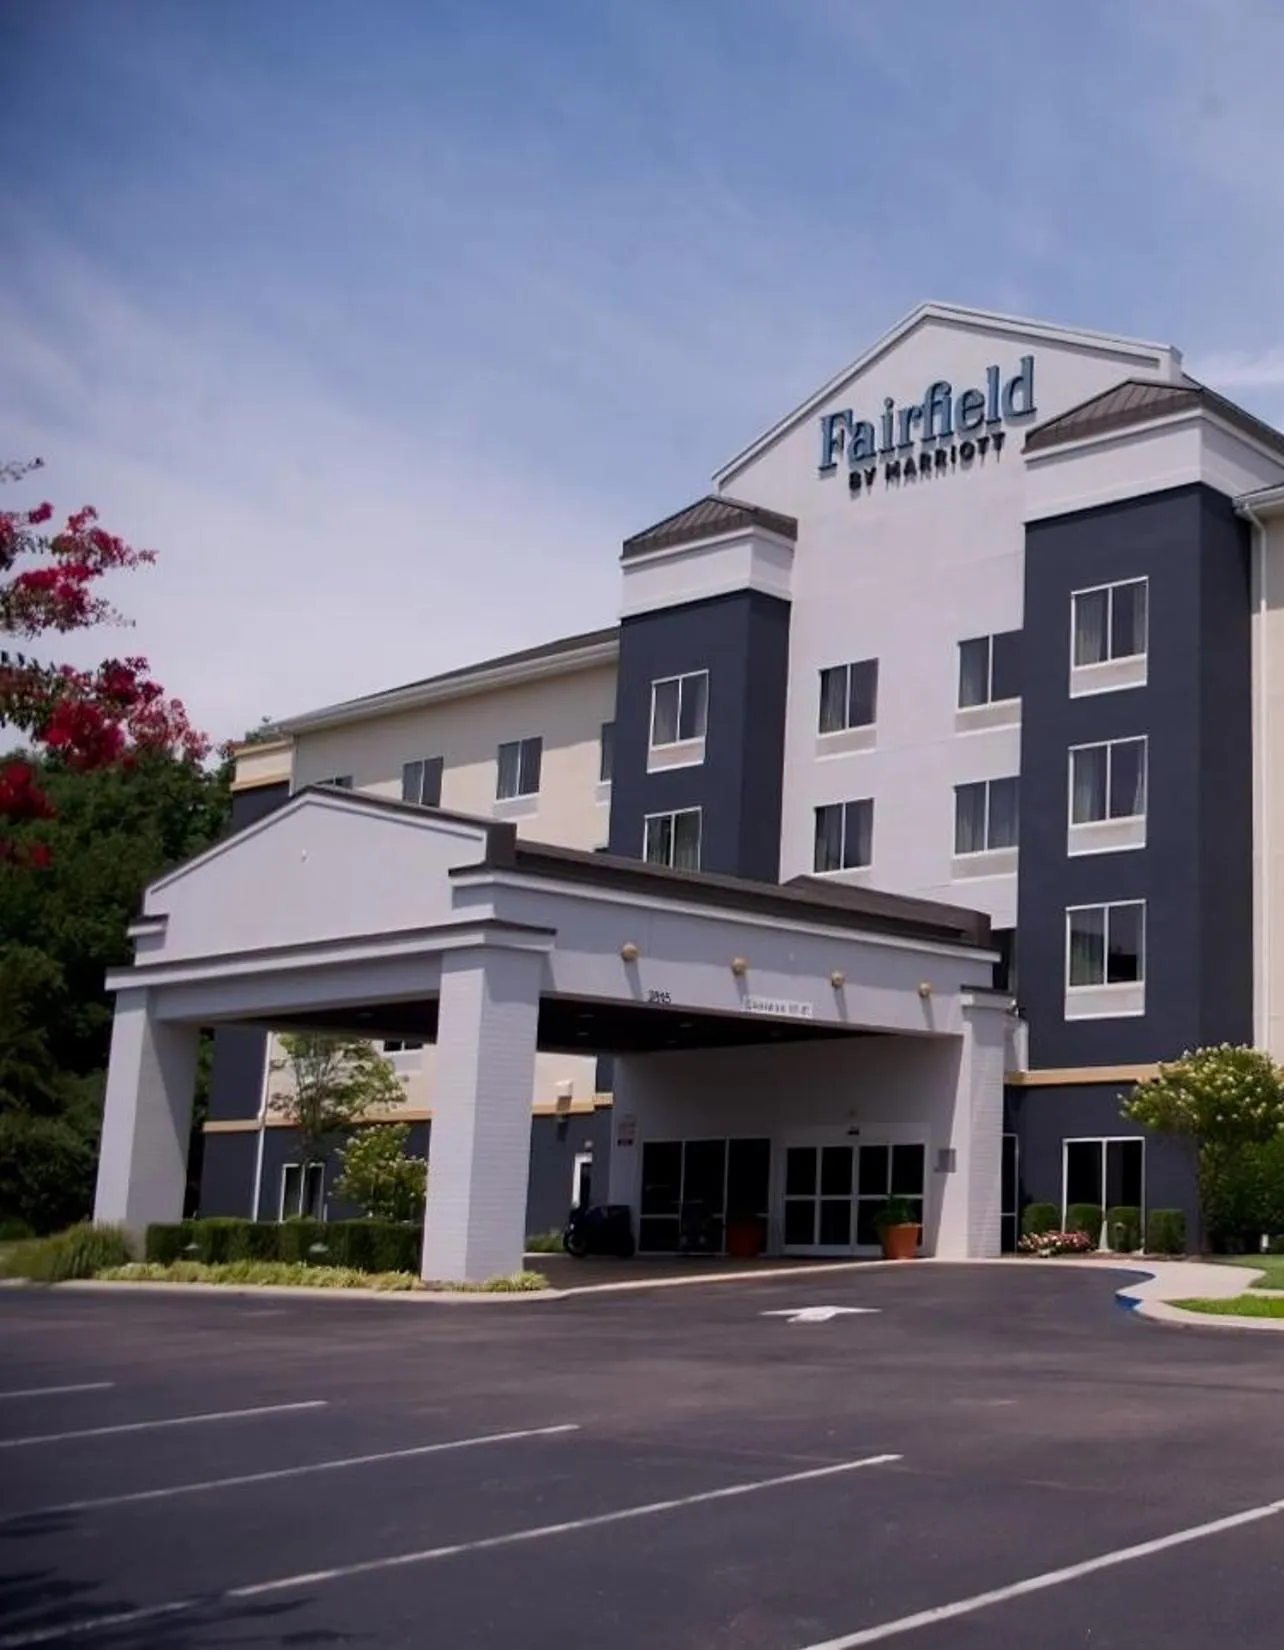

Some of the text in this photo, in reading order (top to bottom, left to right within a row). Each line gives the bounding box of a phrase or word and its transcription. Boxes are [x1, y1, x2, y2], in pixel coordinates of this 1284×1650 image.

[818, 355, 1037, 470] Fairfield
[849, 432, 1005, 490] BY MARRIOTT
